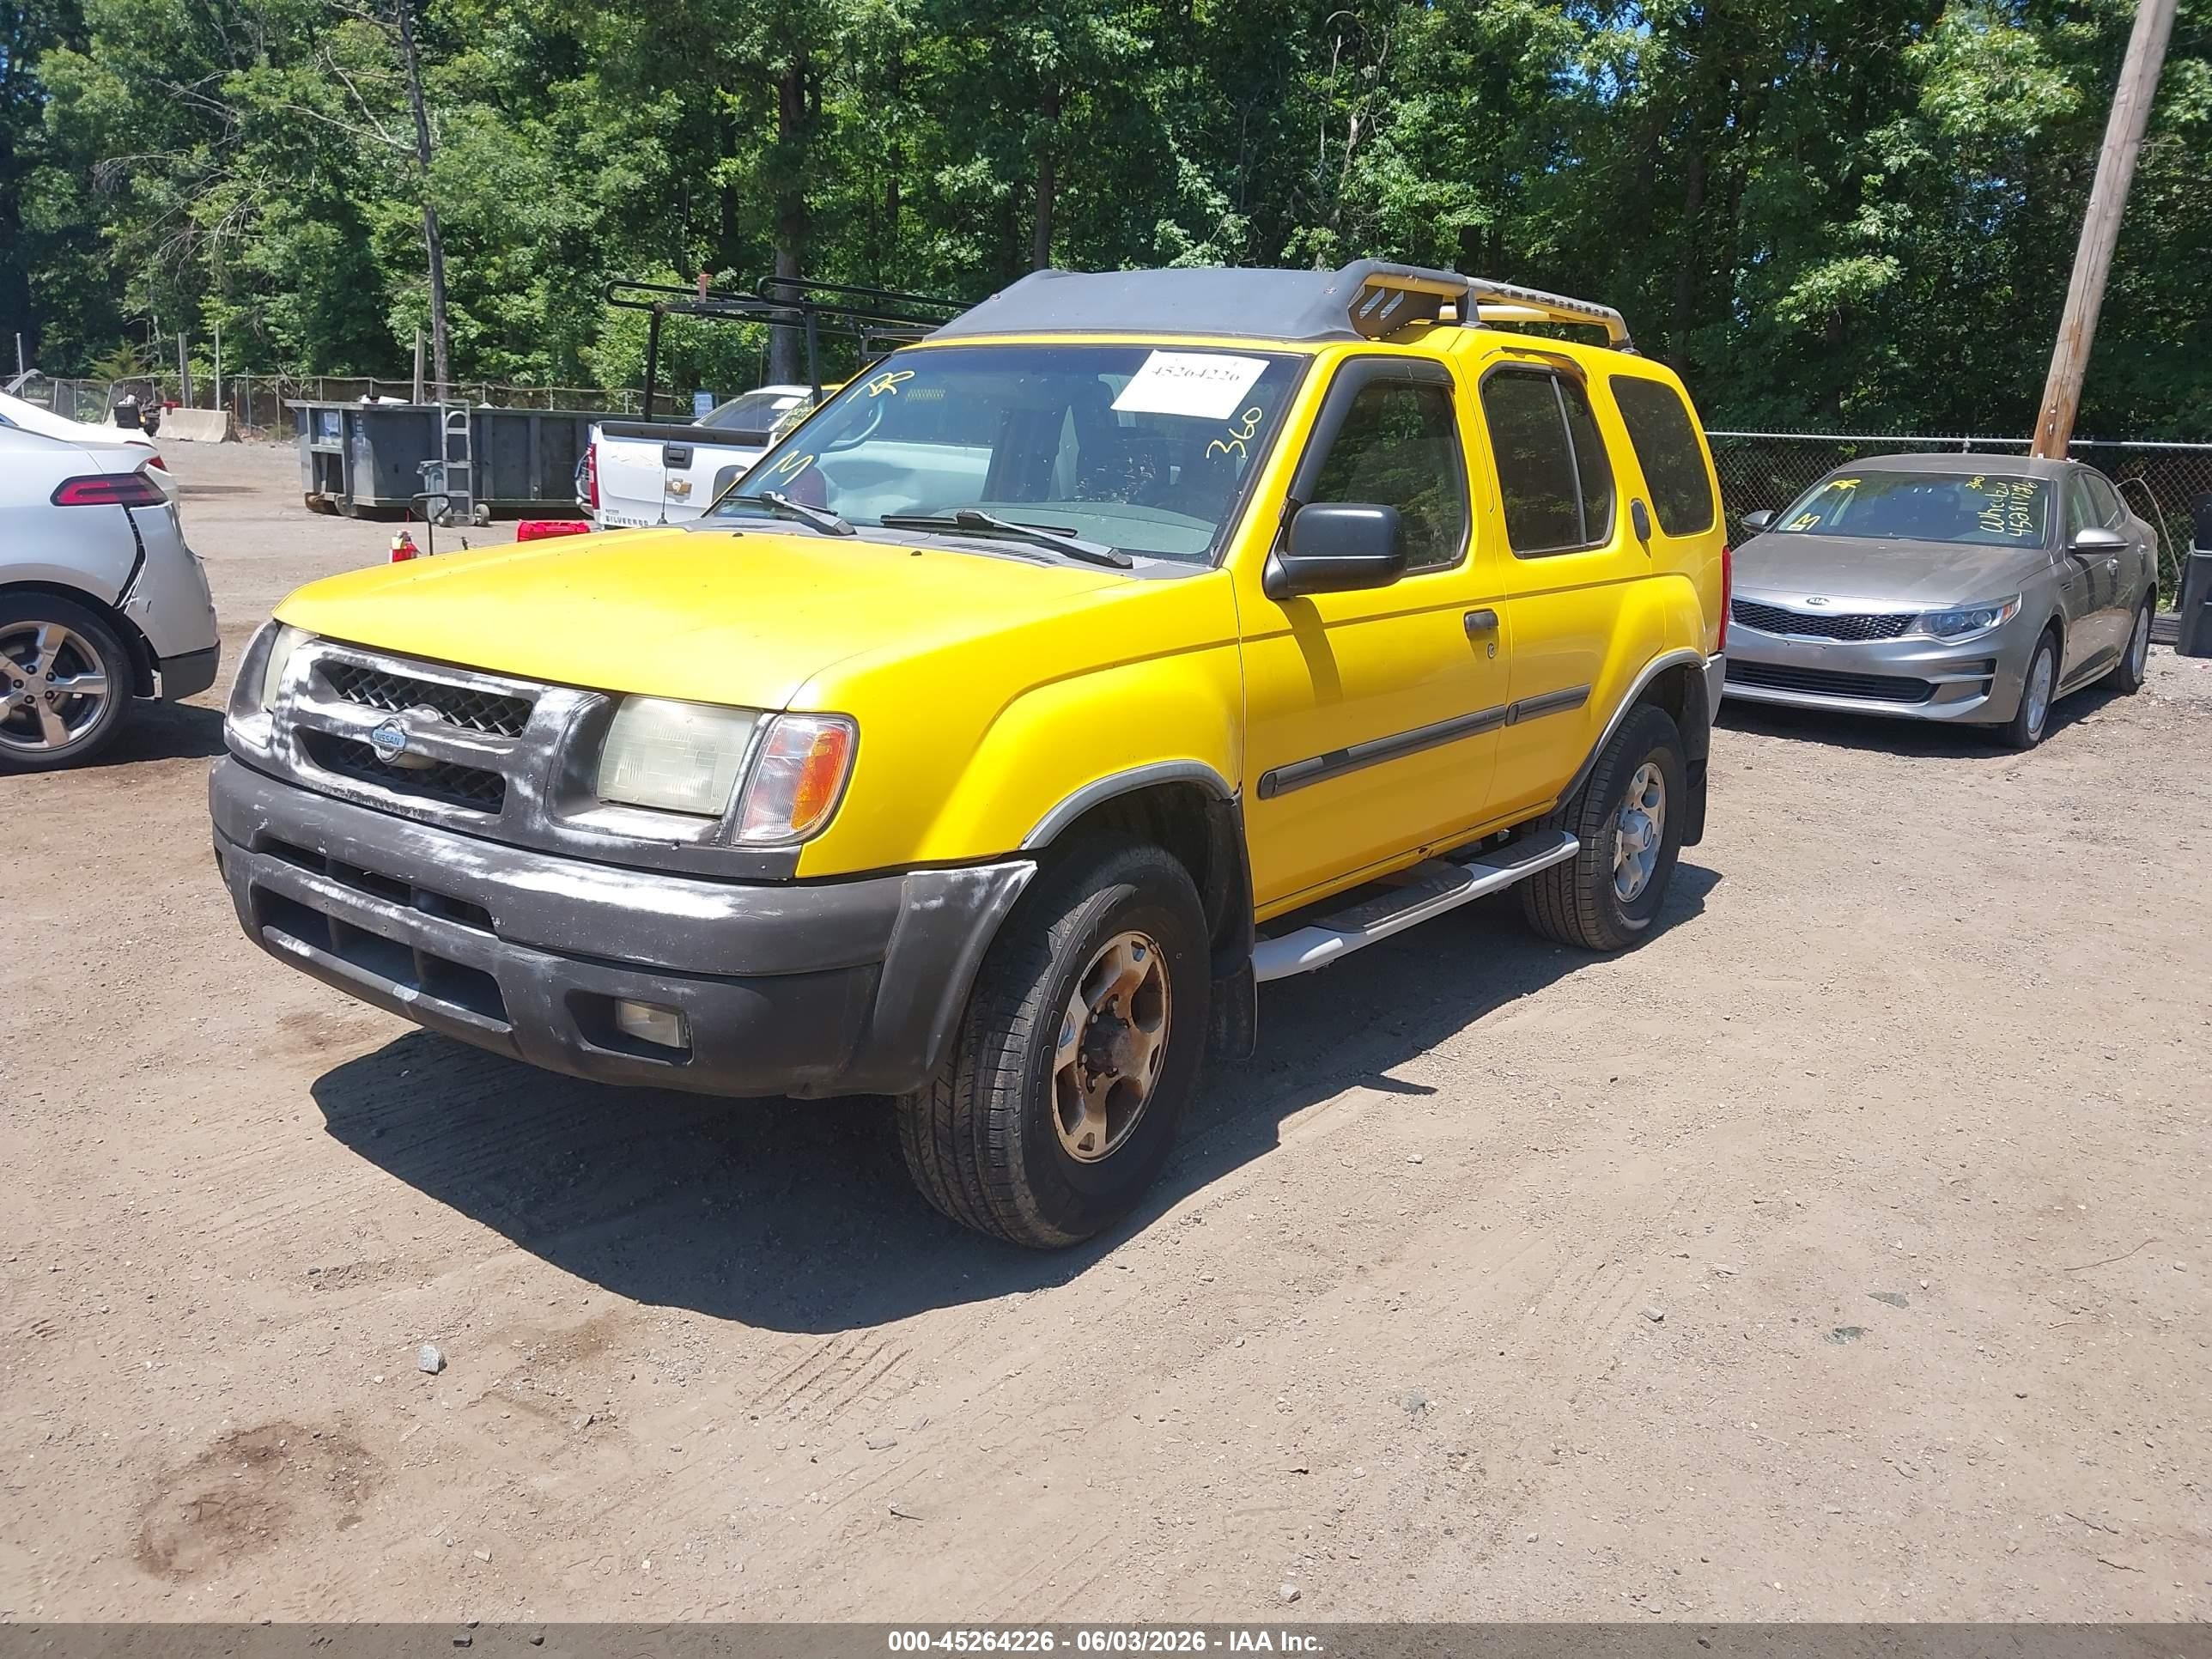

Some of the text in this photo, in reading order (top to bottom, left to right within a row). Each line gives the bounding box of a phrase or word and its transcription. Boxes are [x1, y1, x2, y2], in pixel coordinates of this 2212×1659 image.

[1206, 406, 1263, 459] 360
[1965, 476, 1985, 490] 360
[605, 514, 649, 526] SILVERADO
[375, 733, 400, 744] NISSAN
